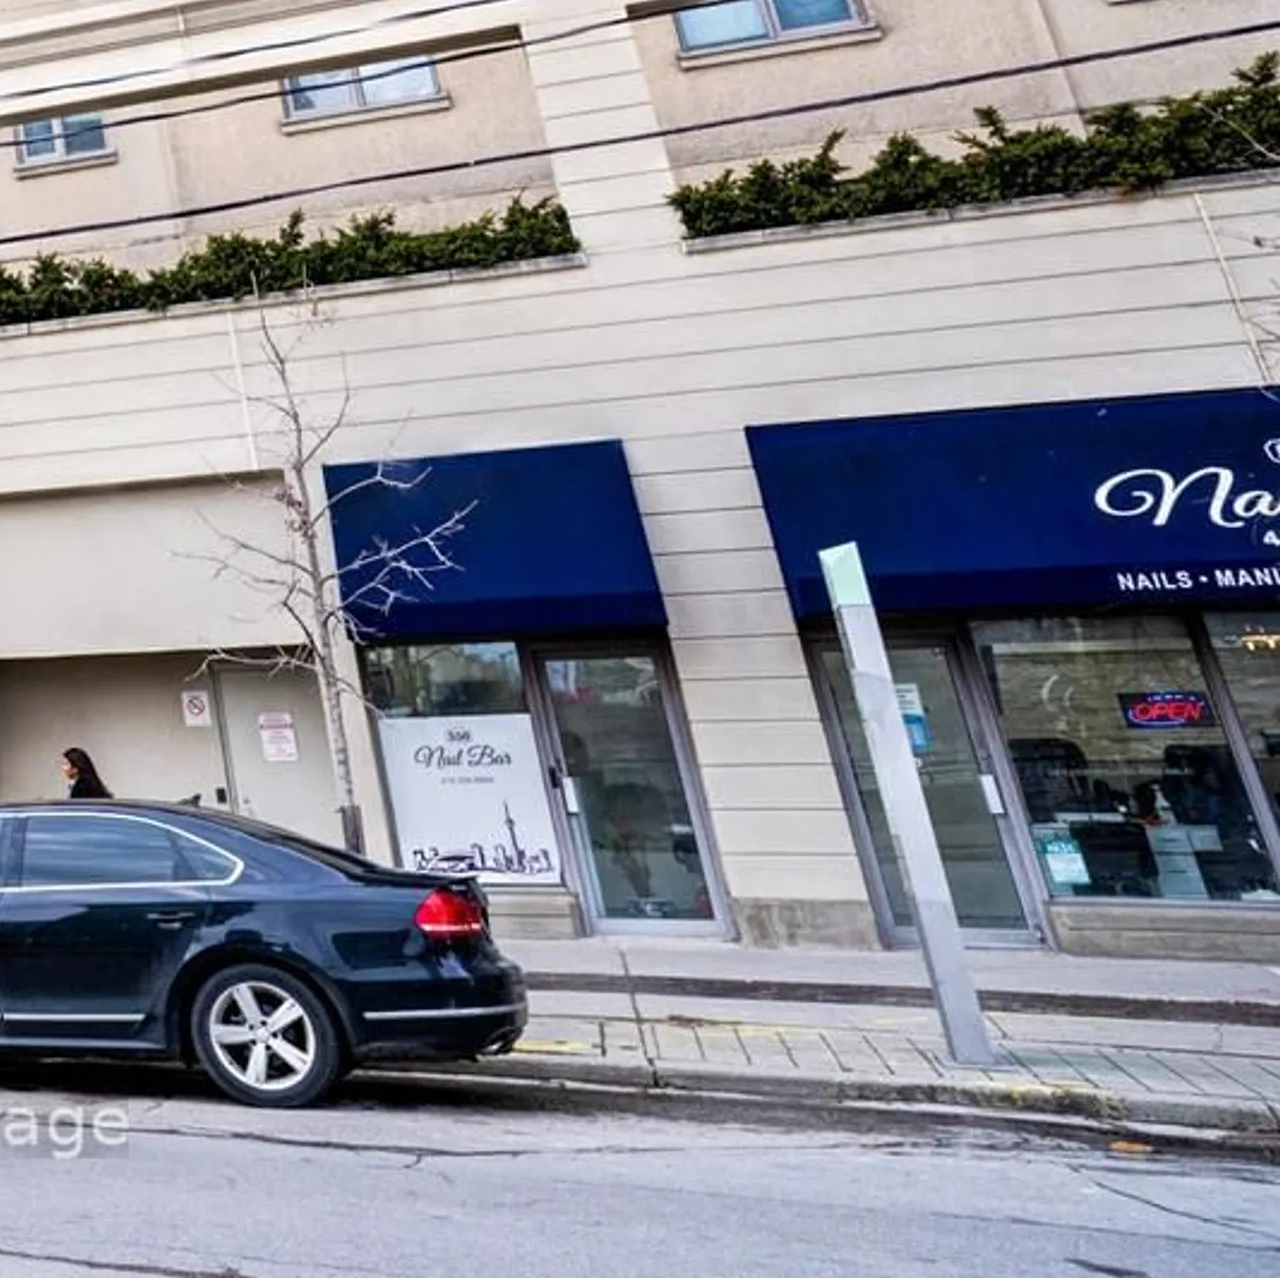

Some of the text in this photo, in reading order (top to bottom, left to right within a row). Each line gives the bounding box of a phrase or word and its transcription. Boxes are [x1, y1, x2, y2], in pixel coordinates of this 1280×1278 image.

[1117, 571, 1192, 590] NAILS
[1135, 703, 1203, 721] OPEN
[466, 744, 512, 768] Bar
